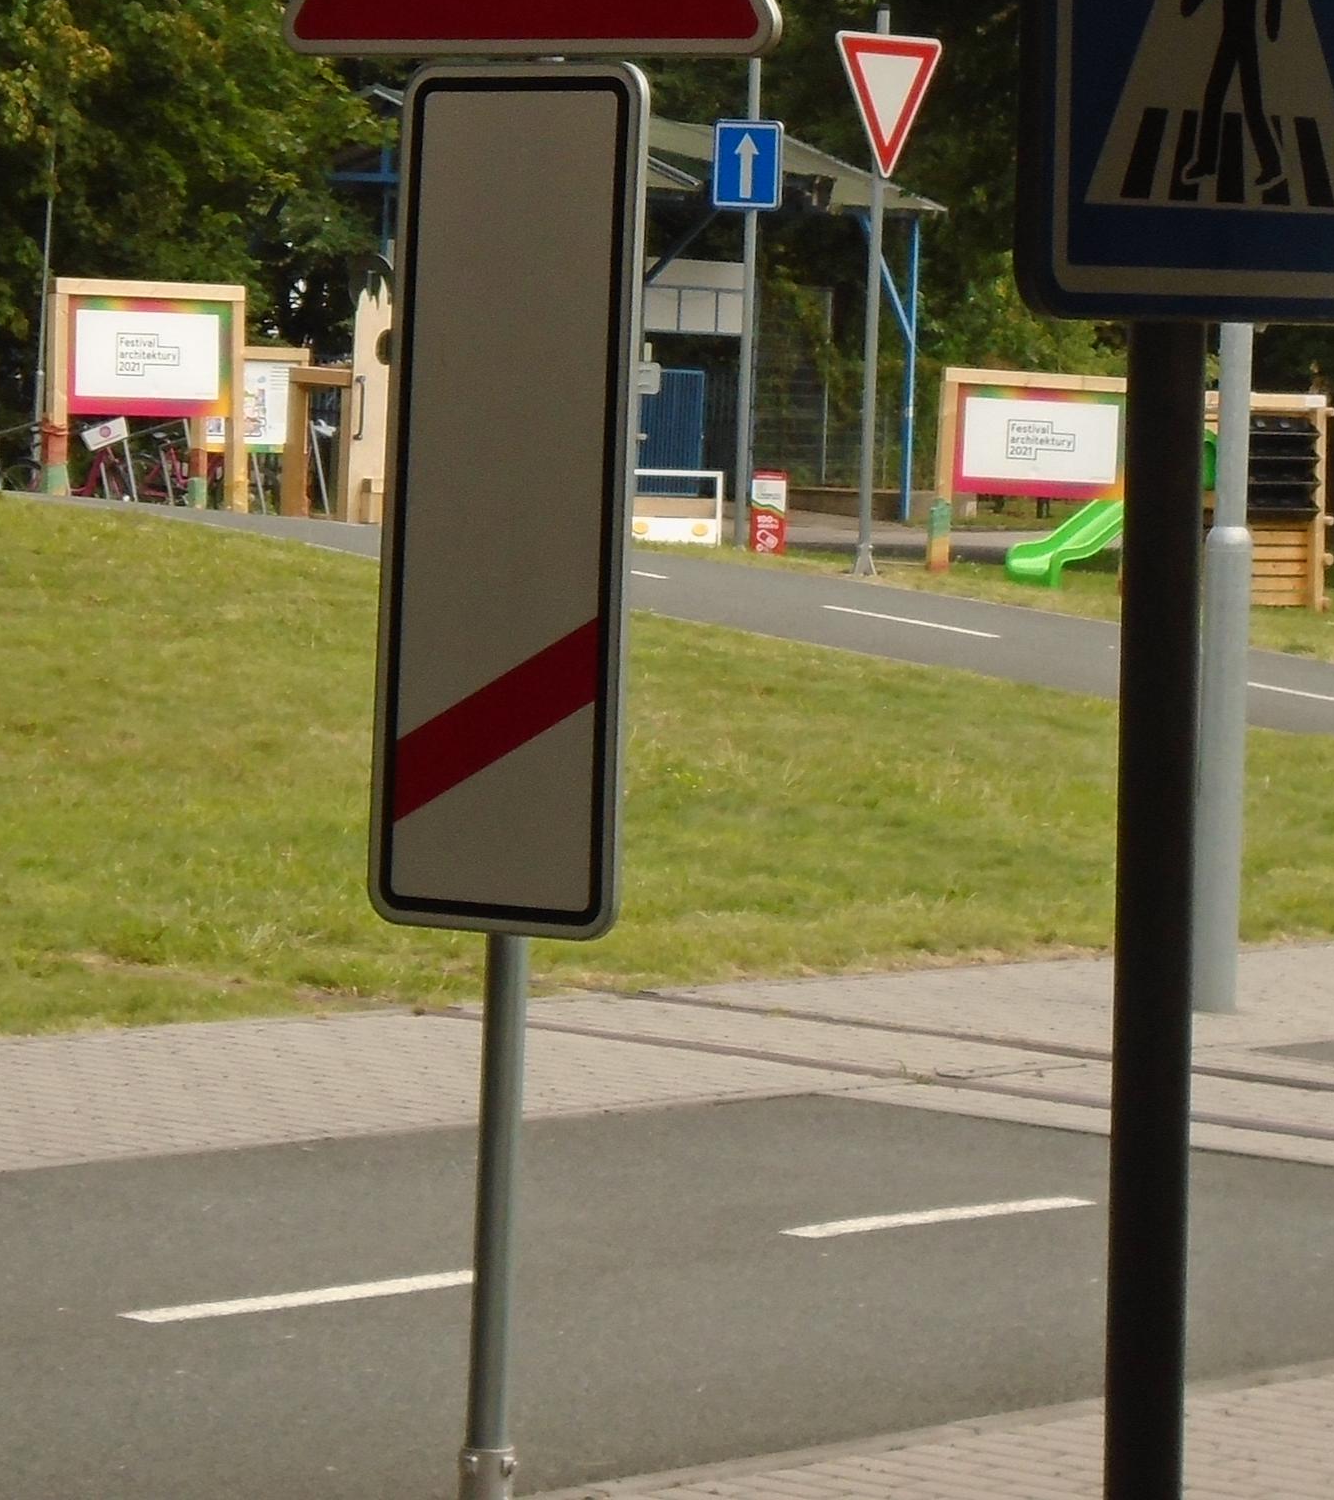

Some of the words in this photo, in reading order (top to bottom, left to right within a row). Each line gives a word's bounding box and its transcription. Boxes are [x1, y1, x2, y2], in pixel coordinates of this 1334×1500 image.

[119, 336, 156, 348] Festival
[119, 350, 177, 362] architektury
[119, 361, 141, 372] 2021
[1010, 423, 1050, 435] Festival
[1010, 435, 1073, 448] architektury
[1009, 446, 1033, 456] 2021
